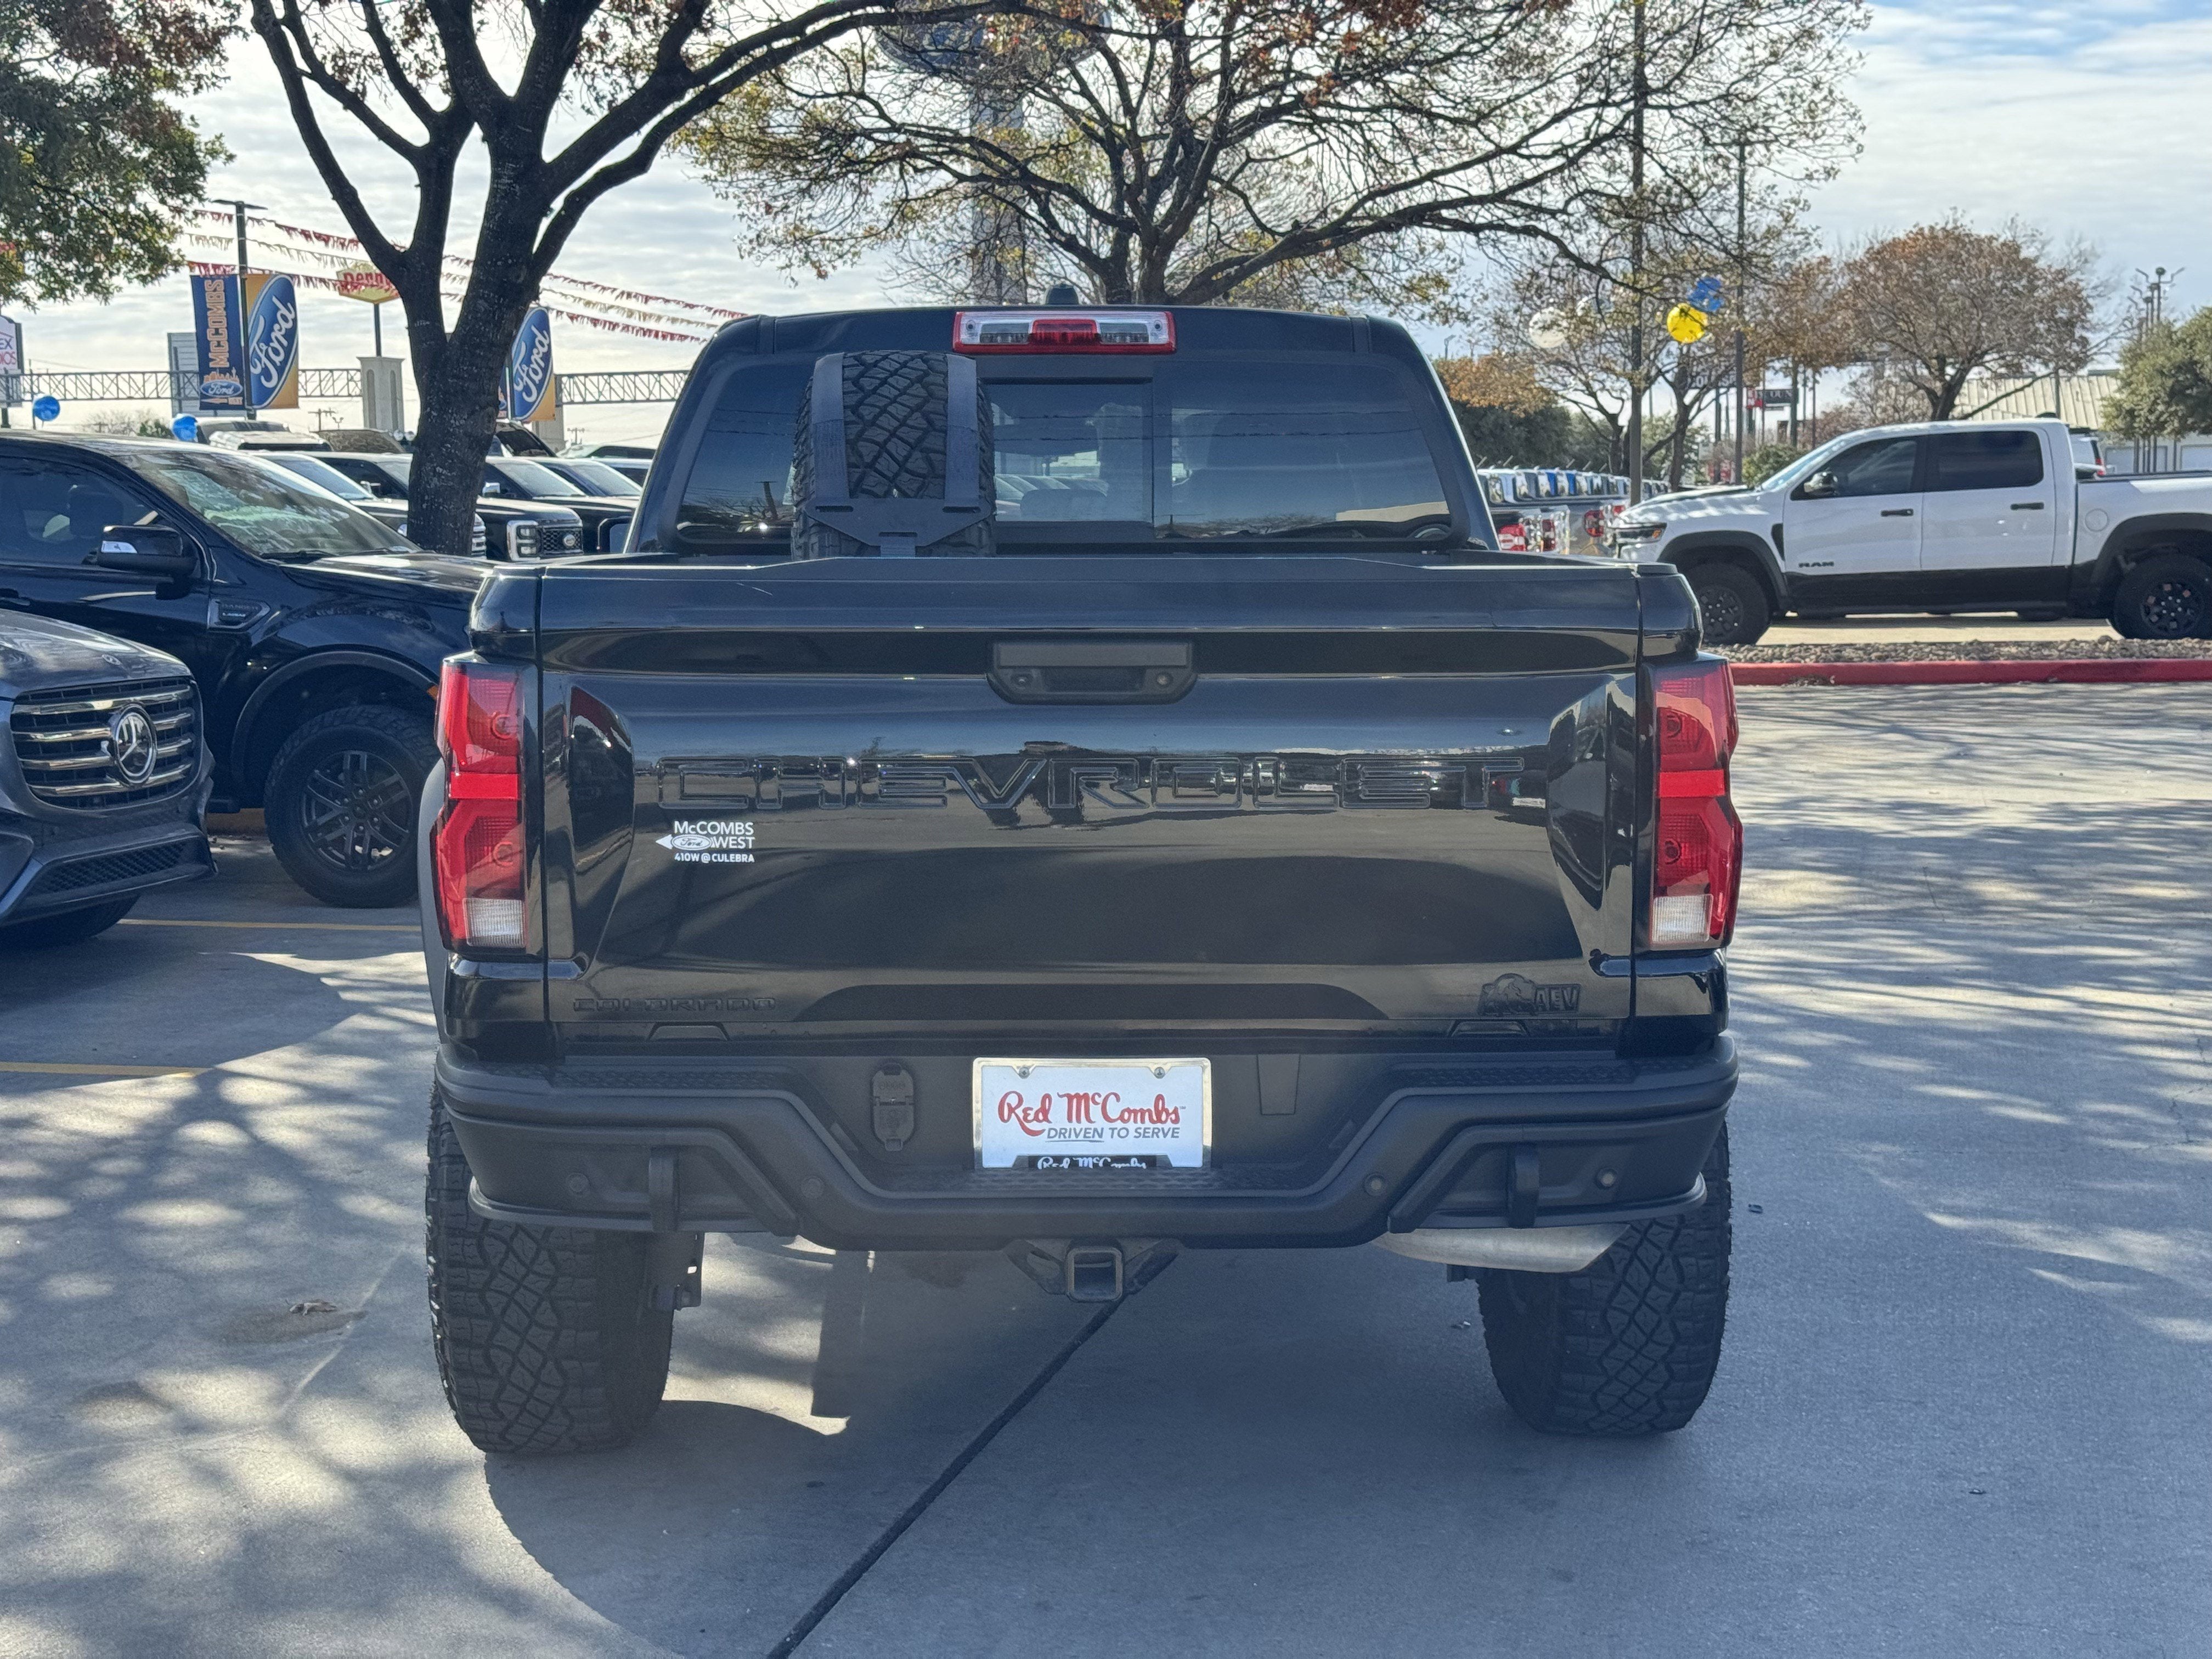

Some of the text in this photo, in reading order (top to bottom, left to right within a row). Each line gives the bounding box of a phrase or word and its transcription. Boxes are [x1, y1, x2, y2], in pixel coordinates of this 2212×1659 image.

[250, 295, 296, 388] Ford
[514, 325, 550, 403] Ford
[208, 383, 234, 394] Ford
[658, 756, 1525, 809] CHEVROLET
[674, 821, 754, 836] McCOMBS
[680, 837, 755, 849] Ford WEST
[674, 853, 699, 862] 410W
[712, 854, 755, 863] CULEBRA
[573, 997, 776, 1012] COLORADO
[1537, 988, 1579, 1012] AEV
[997, 1091, 1181, 1137] Red McCombs
[1047, 1127, 1181, 1139] DRIVEN TO SERVE
